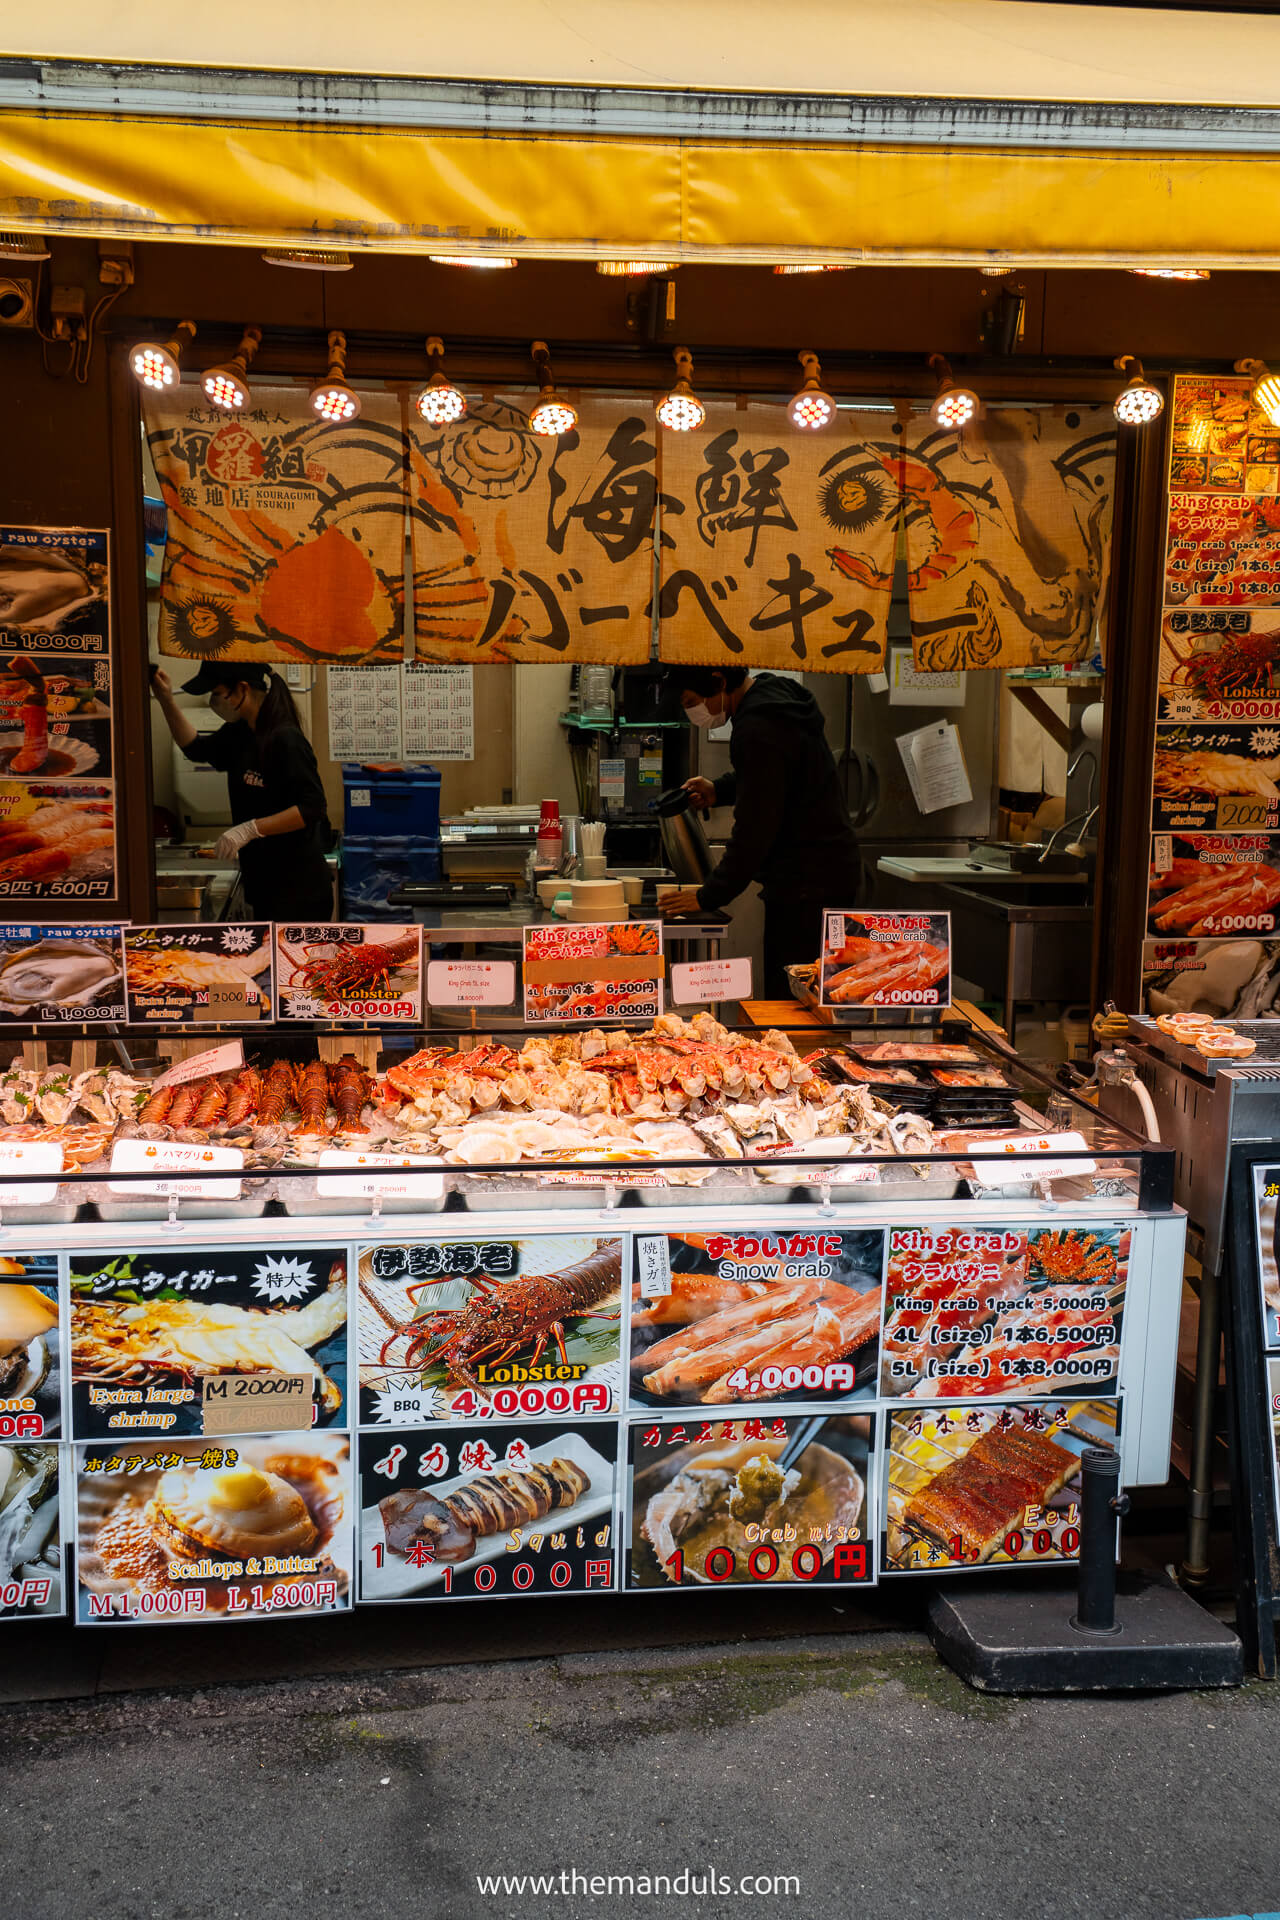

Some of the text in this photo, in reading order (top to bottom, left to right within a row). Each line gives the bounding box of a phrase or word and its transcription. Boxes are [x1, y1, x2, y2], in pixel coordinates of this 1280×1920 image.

[169, 430, 307, 481] 甲羅組
[180, 487, 249, 507] 築地店
[256, 490, 315, 501] KOURAGUMI
[546, 416, 799, 567] 海鮮
[256, 500, 295, 511] TSUKIJI
[1171, 495, 1250, 510] King crab
[1178, 517, 1239, 529] タラバガニ
[8, 534, 97, 546] raw oyster
[1174, 540, 1260, 550] King crab 1pack
[1172, 560, 1188, 570] 4L
[1171, 582, 1187, 592] 5L
[477, 552, 978, 660] バーベキュー
[1171, 612, 1247, 630] 伊勢海老
[21, 632, 102, 651] 1,000円
[1167, 735, 1242, 747] シータイガー
[1255, 736, 1276, 746] 特大
[1193, 837, 1270, 850] ずわいがに
[1200, 851, 1263, 863] Snow crab
[864, 917, 931, 930] ずわいがに
[1203, 914, 1275, 930] 4,000円
[47, 928, 121, 937] raw oyster
[135, 934, 213, 947] シータイガー
[228, 935, 249, 945] 特大
[285, 927, 362, 941] 伊勢海老
[532, 929, 604, 942] King crab
[870, 930, 926, 941] Snow crab
[539, 946, 593, 958] タラバガニ
[342, 988, 401, 999] Lobster
[575, 985, 595, 994] 1本
[606, 983, 654, 994] 6,500円
[874, 989, 939, 1004] 4,000円
[196, 992, 209, 1003] M
[42, 1005, 126, 1020] L 1,000円
[328, 1001, 414, 1017] 4,000円
[528, 1010, 539, 1018] 5L
[575, 1006, 595, 1016] 1本
[606, 1004, 655, 1015] 8,000円
[163, 1150, 200, 1161] ハマグリ
[705, 1236, 843, 1260] ずわいがに
[892, 1231, 1021, 1253] King crab
[373, 1243, 513, 1275] 伊勢海老
[643, 1241, 660, 1292] 焼きガニ
[720, 1260, 831, 1279] Snow crab
[903, 1262, 1001, 1282] タラバガニ
[92, 1269, 238, 1293] シータイガー
[266, 1272, 302, 1288] 特大
[895, 1296, 1107, 1312] King crab 1pack 5,000円
[893, 1327, 919, 1343] 4L
[1003, 1325, 1116, 1345] 1本6,500円
[477, 1362, 587, 1383] Lobster
[892, 1360, 918, 1377] 5L
[1000, 1358, 1113, 1378] 1本8,000円
[727, 1363, 855, 1392] 4,000円
[91, 1387, 194, 1404] Extra large
[206, 1379, 304, 1400] M 2000円
[393, 1399, 421, 1412] BBQ
[451, 1384, 611, 1417] 4,000円
[109, 1411, 177, 1428] shrimp
[908, 1408, 1070, 1436] うなぎ串焼き
[84, 1449, 239, 1473] ホタテバター焼き
[374, 1439, 531, 1477] イカ焼き
[1023, 1503, 1079, 1529] Eel
[505, 1526, 611, 1552] Squid
[744, 1523, 861, 1543] Crab miso
[371, 1541, 435, 1569] 1本
[665, 1544, 867, 1582] 1000円
[912, 1549, 941, 1563] 1本
[168, 1556, 319, 1582] Scallops & Butter
[441, 1559, 612, 1593] 1000円
[88, 1589, 207, 1618] M 1,000円
[227, 1581, 337, 1610] L 1,800円
